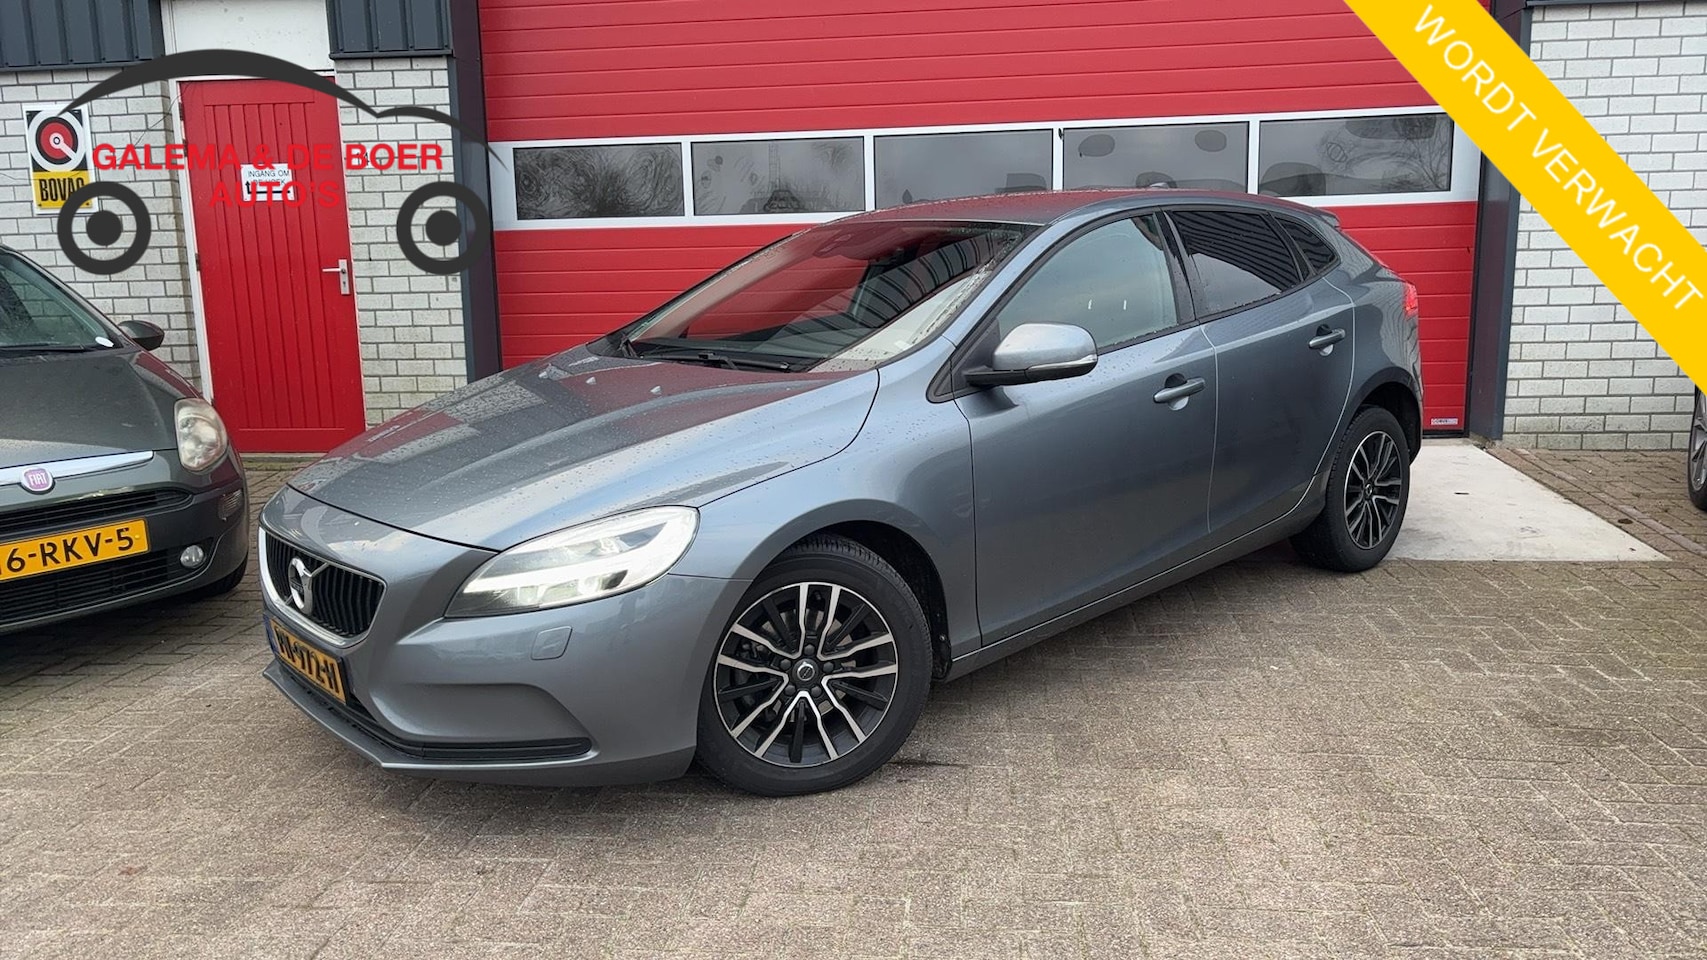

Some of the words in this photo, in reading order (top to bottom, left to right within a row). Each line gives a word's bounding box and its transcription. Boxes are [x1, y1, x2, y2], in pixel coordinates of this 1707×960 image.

[247, 169, 276, 178] INGANG
[277, 169, 290, 177] OM
[29, 472, 47, 486] FIAT
[0, 527, 134, 576] 6-RKV-5
